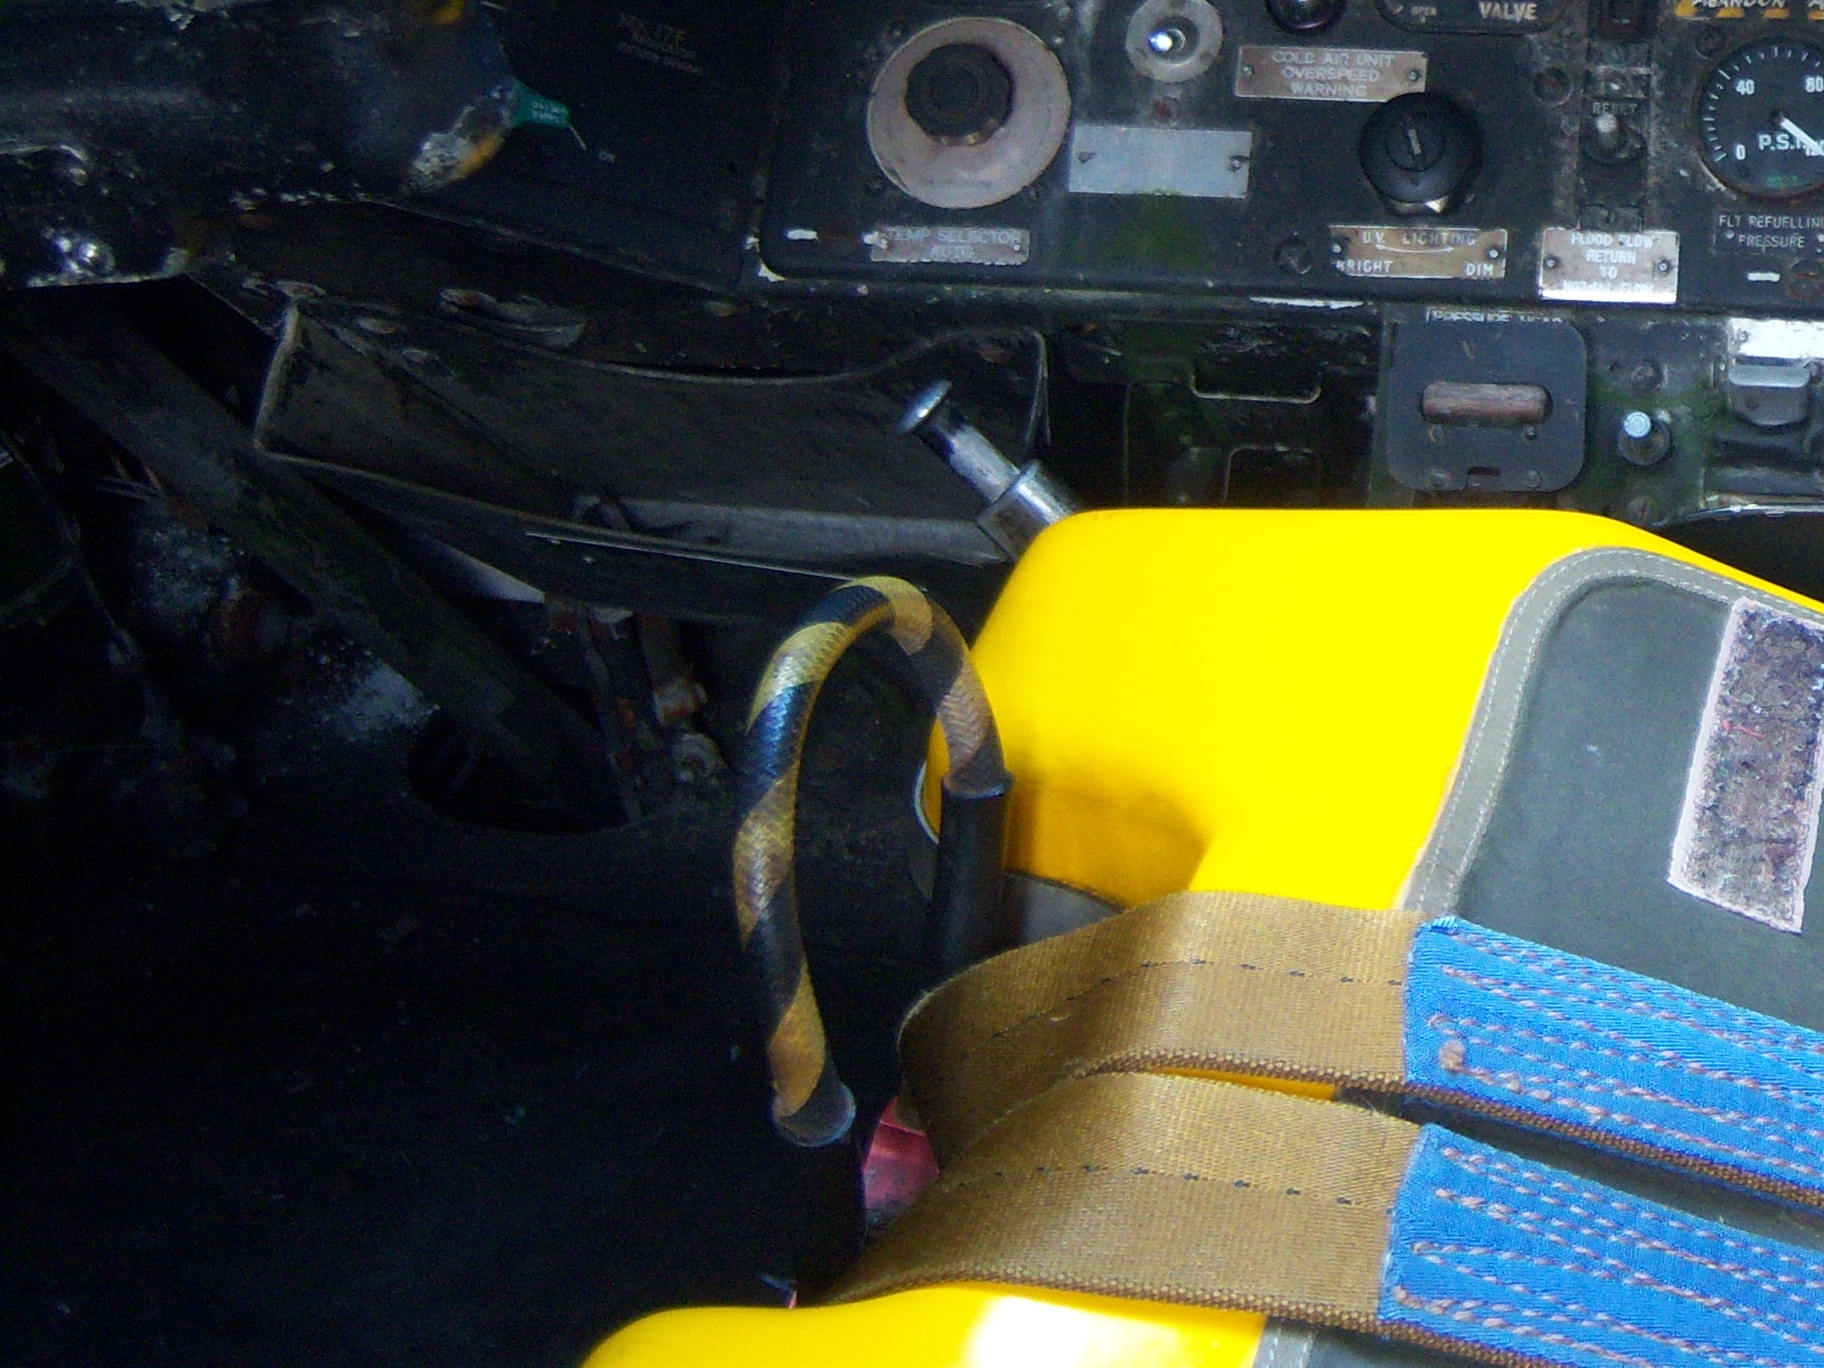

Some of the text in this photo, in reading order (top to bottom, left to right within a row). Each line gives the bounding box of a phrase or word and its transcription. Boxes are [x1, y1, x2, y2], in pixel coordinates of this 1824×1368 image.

[1476, 0, 1539, 23] VALVE
[1270, 50, 1316, 65] COLD
[1356, 52, 1395, 67] UNIT
[1281, 66, 1380, 83] OVERSPEED
[1289, 81, 1368, 98] WARNING
[1735, 78, 1756, 96] 40
[1804, 75, 1824, 94] 80
[1735, 144, 1747, 161] 0
[1718, 214, 1742, 229] FLT
[1400, 231, 1477, 246] LIGHTING
[1570, 233, 1613, 247] FLOOD
[1737, 234, 1806, 250] PRESSURE
[1585, 250, 1637, 264] RETURN
[1465, 263, 1495, 277] DIM
[1599, 266, 1618, 280] TO
